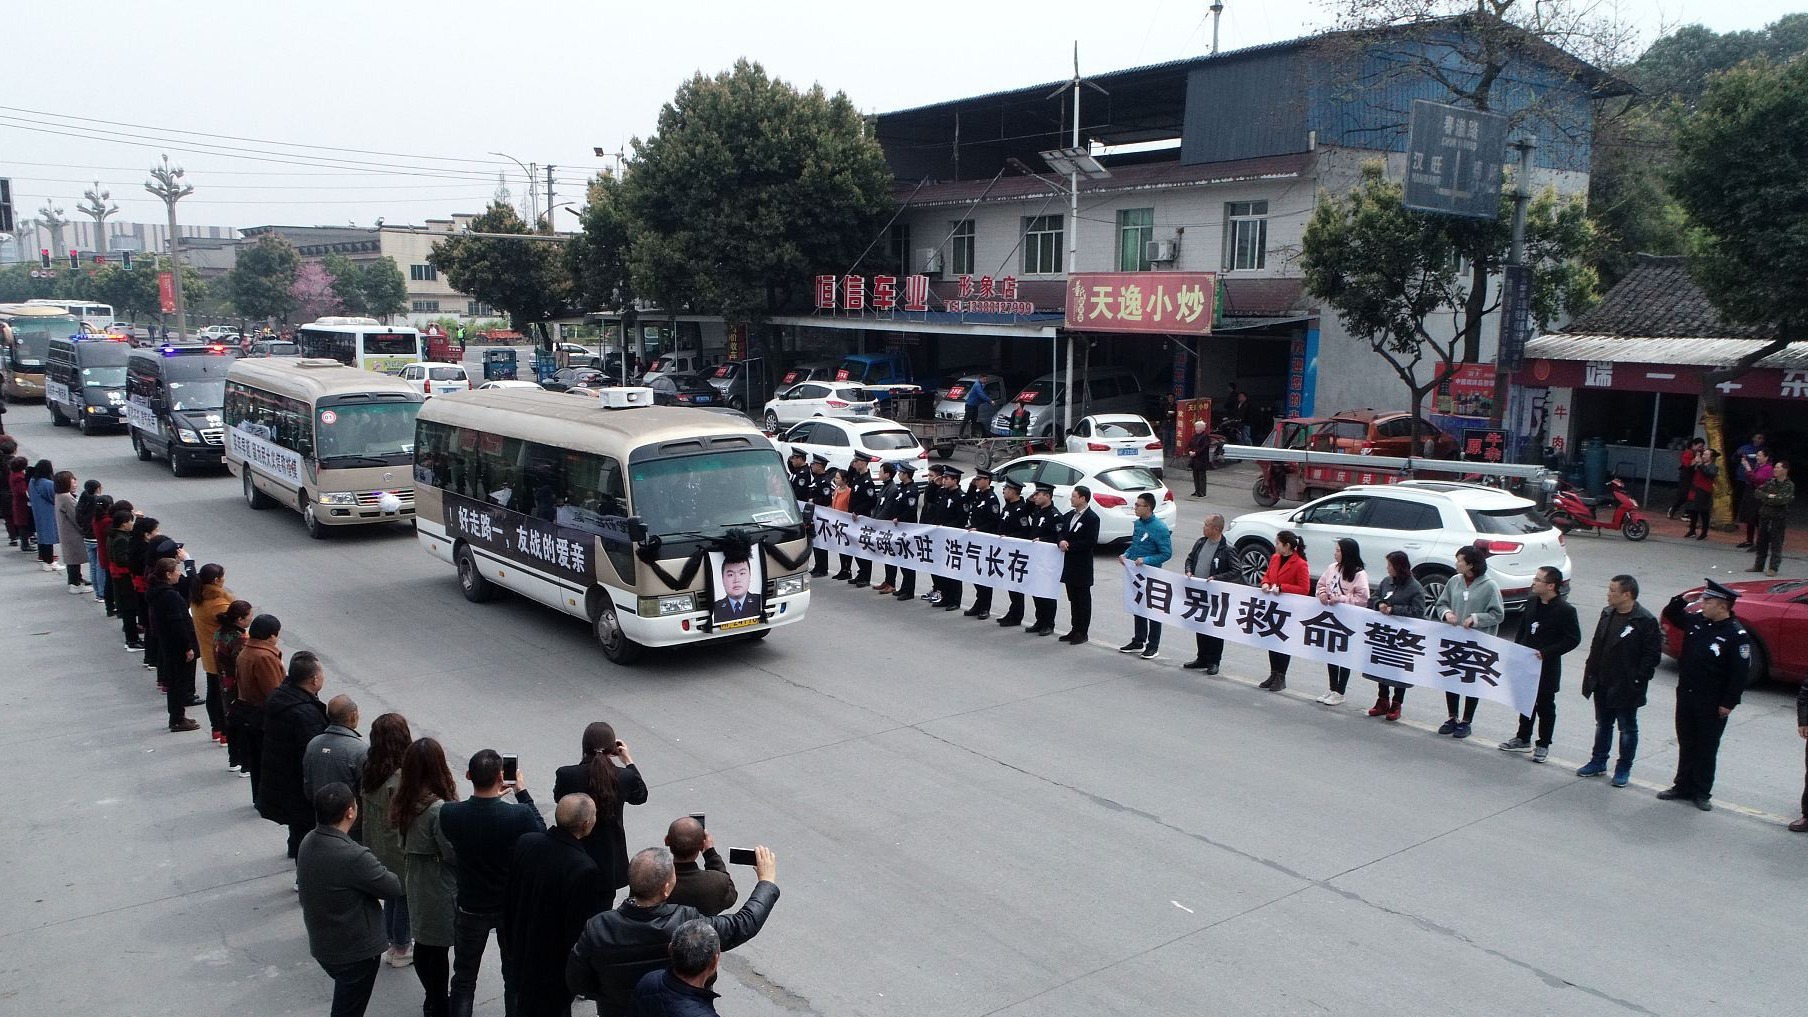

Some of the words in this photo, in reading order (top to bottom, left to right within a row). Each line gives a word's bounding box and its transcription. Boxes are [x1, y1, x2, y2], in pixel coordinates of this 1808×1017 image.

[815, 274, 929, 311] 恒信车业
[958, 275, 1018, 299] 形象店
[1089, 284, 1205, 323] 天逸小炒
[815, 515, 850, 548] 不朽
[858, 525, 935, 566] 英魂永驻
[944, 537, 1030, 585] 浩气长存
[1132, 572, 1503, 687] 泪别救命警察
